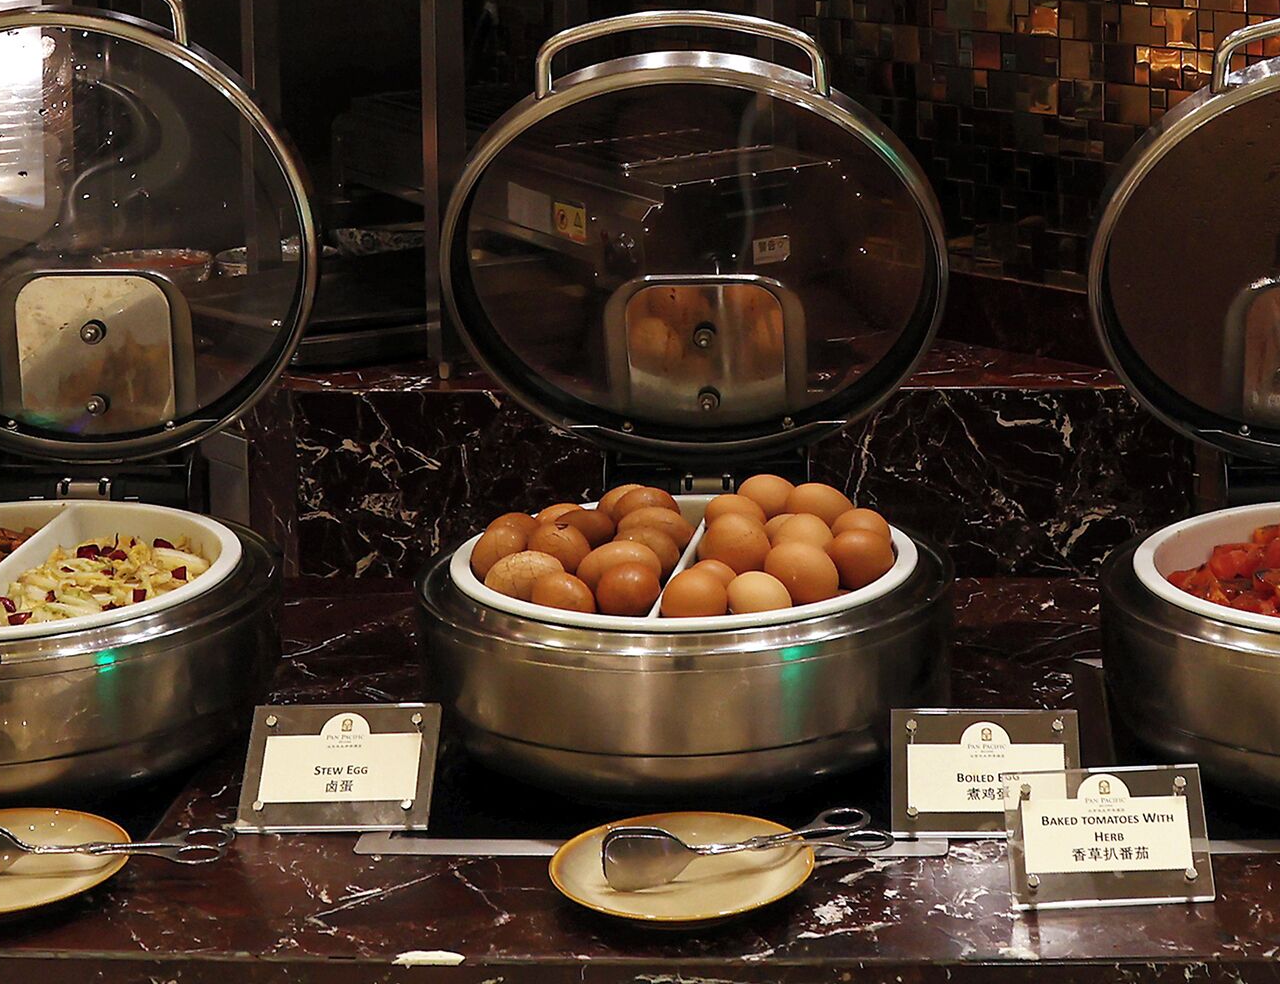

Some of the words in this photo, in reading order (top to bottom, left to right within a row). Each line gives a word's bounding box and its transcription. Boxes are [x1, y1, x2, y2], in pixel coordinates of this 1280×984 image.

[313, 765, 344, 776] STEW
[346, 764, 369, 775] EGG
[956, 772, 995, 783] BOILED
[1041, 815, 1078, 826] BAKED
[1081, 815, 1140, 825] TOMATOES
[1142, 812, 1175, 823] WITH
[1094, 831, 1125, 842] HERB
[1071, 845, 1150, 862] 香草扒番茄
